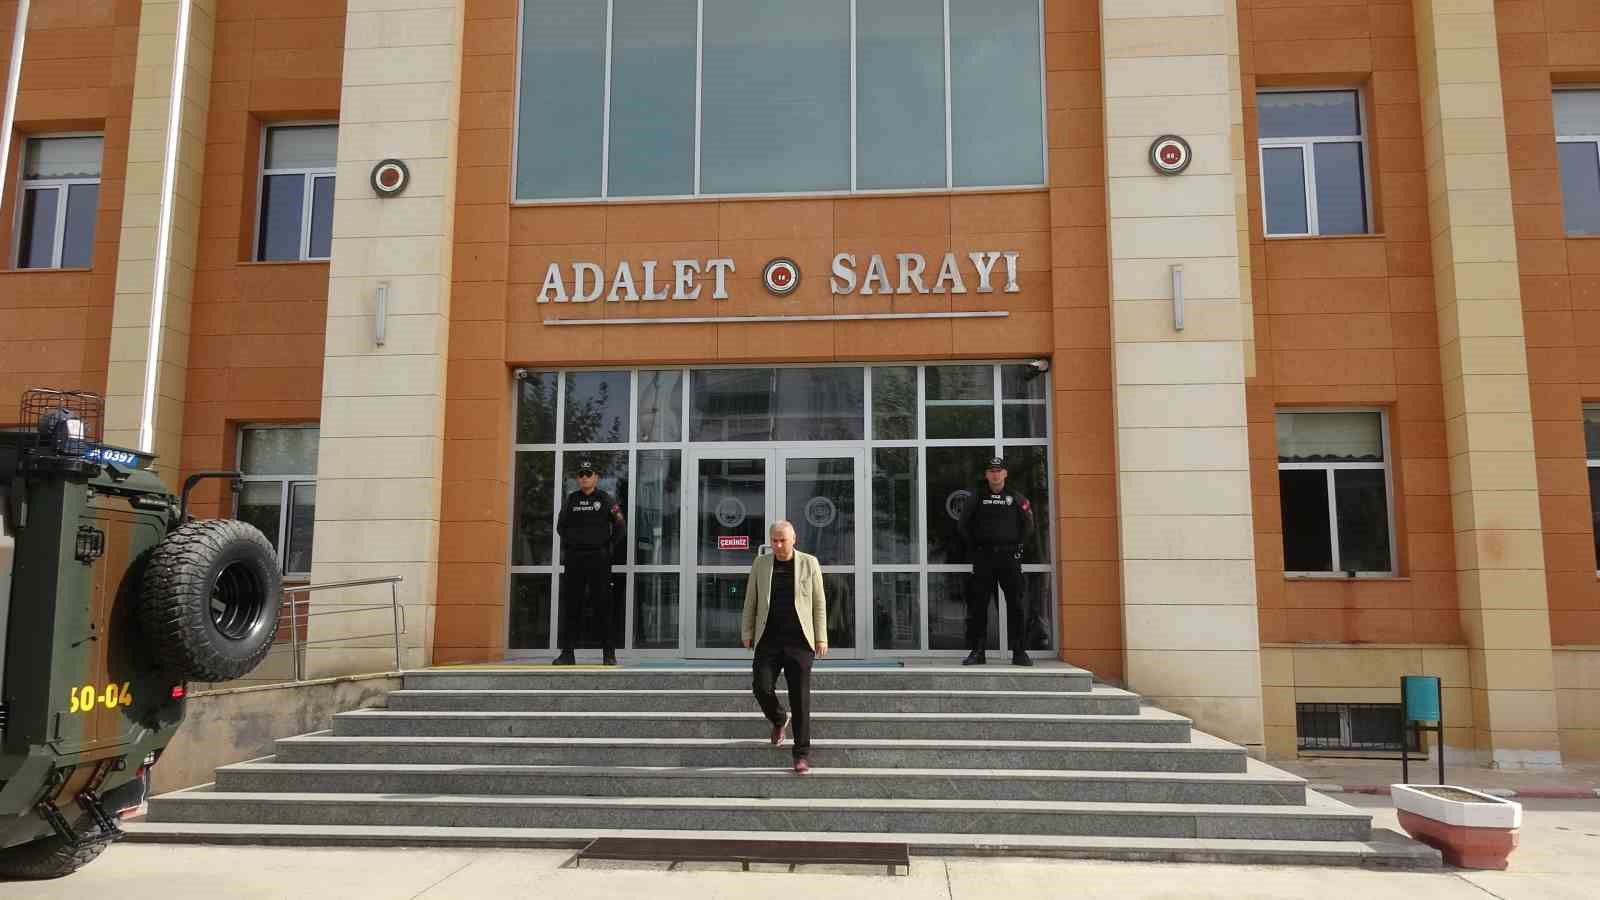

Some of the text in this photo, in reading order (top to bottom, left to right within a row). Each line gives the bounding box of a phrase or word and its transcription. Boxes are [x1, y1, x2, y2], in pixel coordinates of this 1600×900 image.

[536, 251, 1020, 304] ADALET SARAYI
[104, 449, 136, 464] 0397
